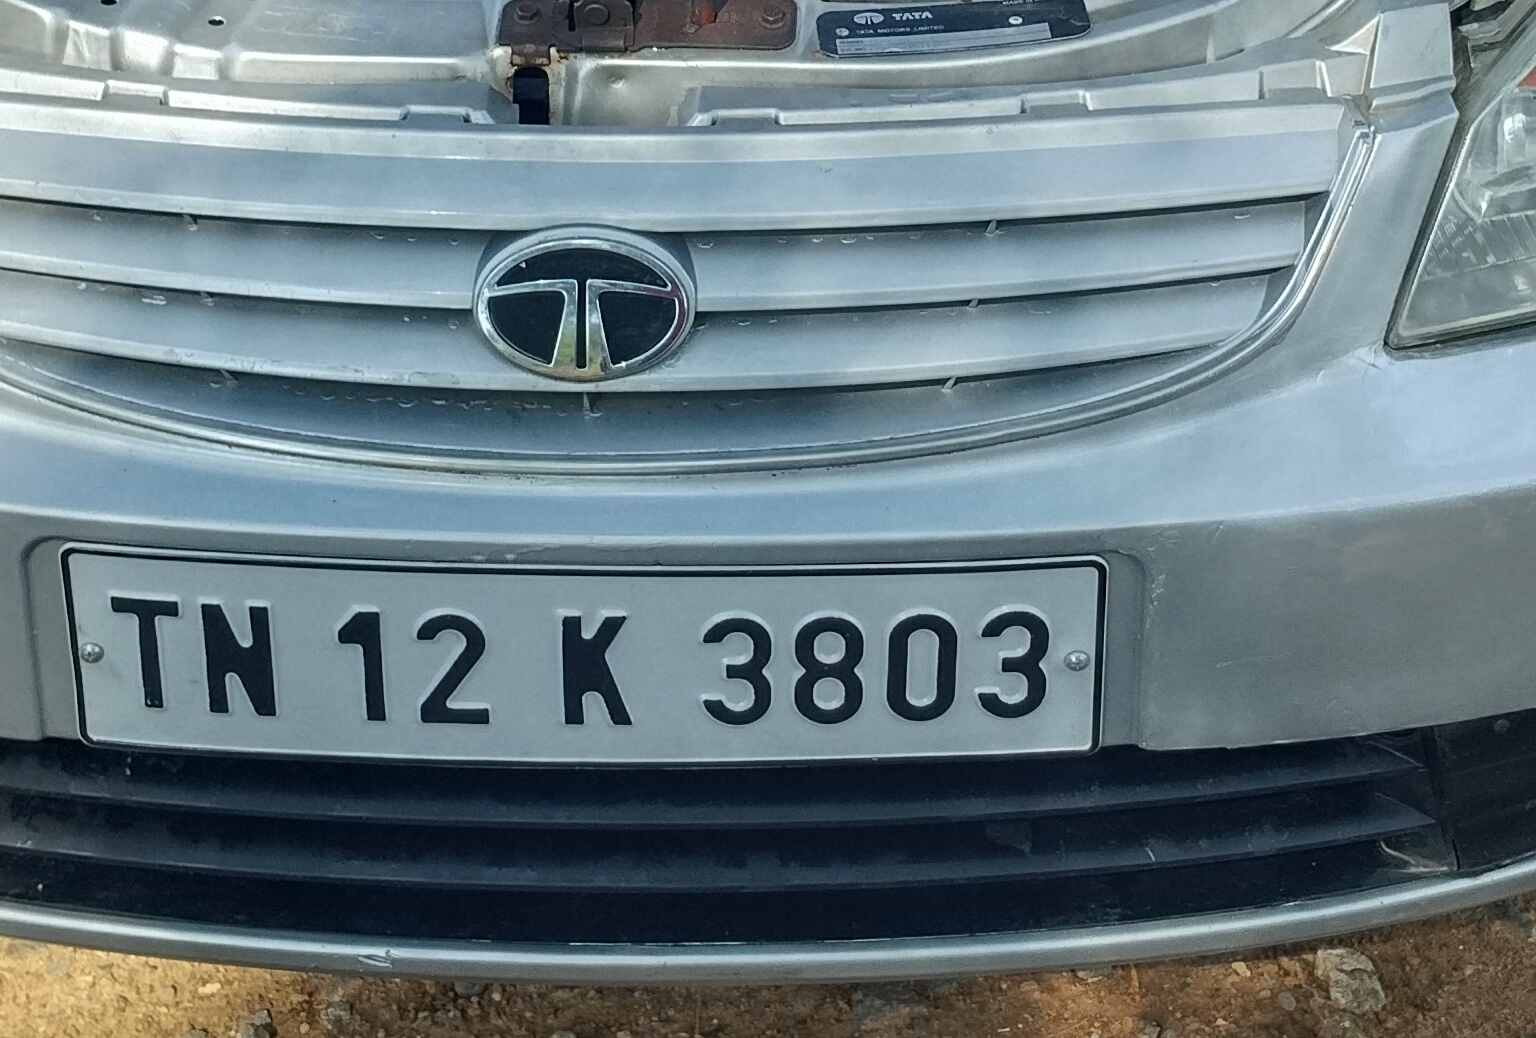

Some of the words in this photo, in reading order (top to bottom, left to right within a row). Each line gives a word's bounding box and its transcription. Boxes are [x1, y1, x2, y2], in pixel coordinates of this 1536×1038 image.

[891, 11, 933, 21] TATA
[877, 26, 911, 34] MOTORS
[913, 24, 945, 33] LIMITED
[109, 594, 278, 717] TN
[335, 609, 492, 726] 12
[560, 612, 635, 727] K
[701, 609, 1052, 726] 3803
